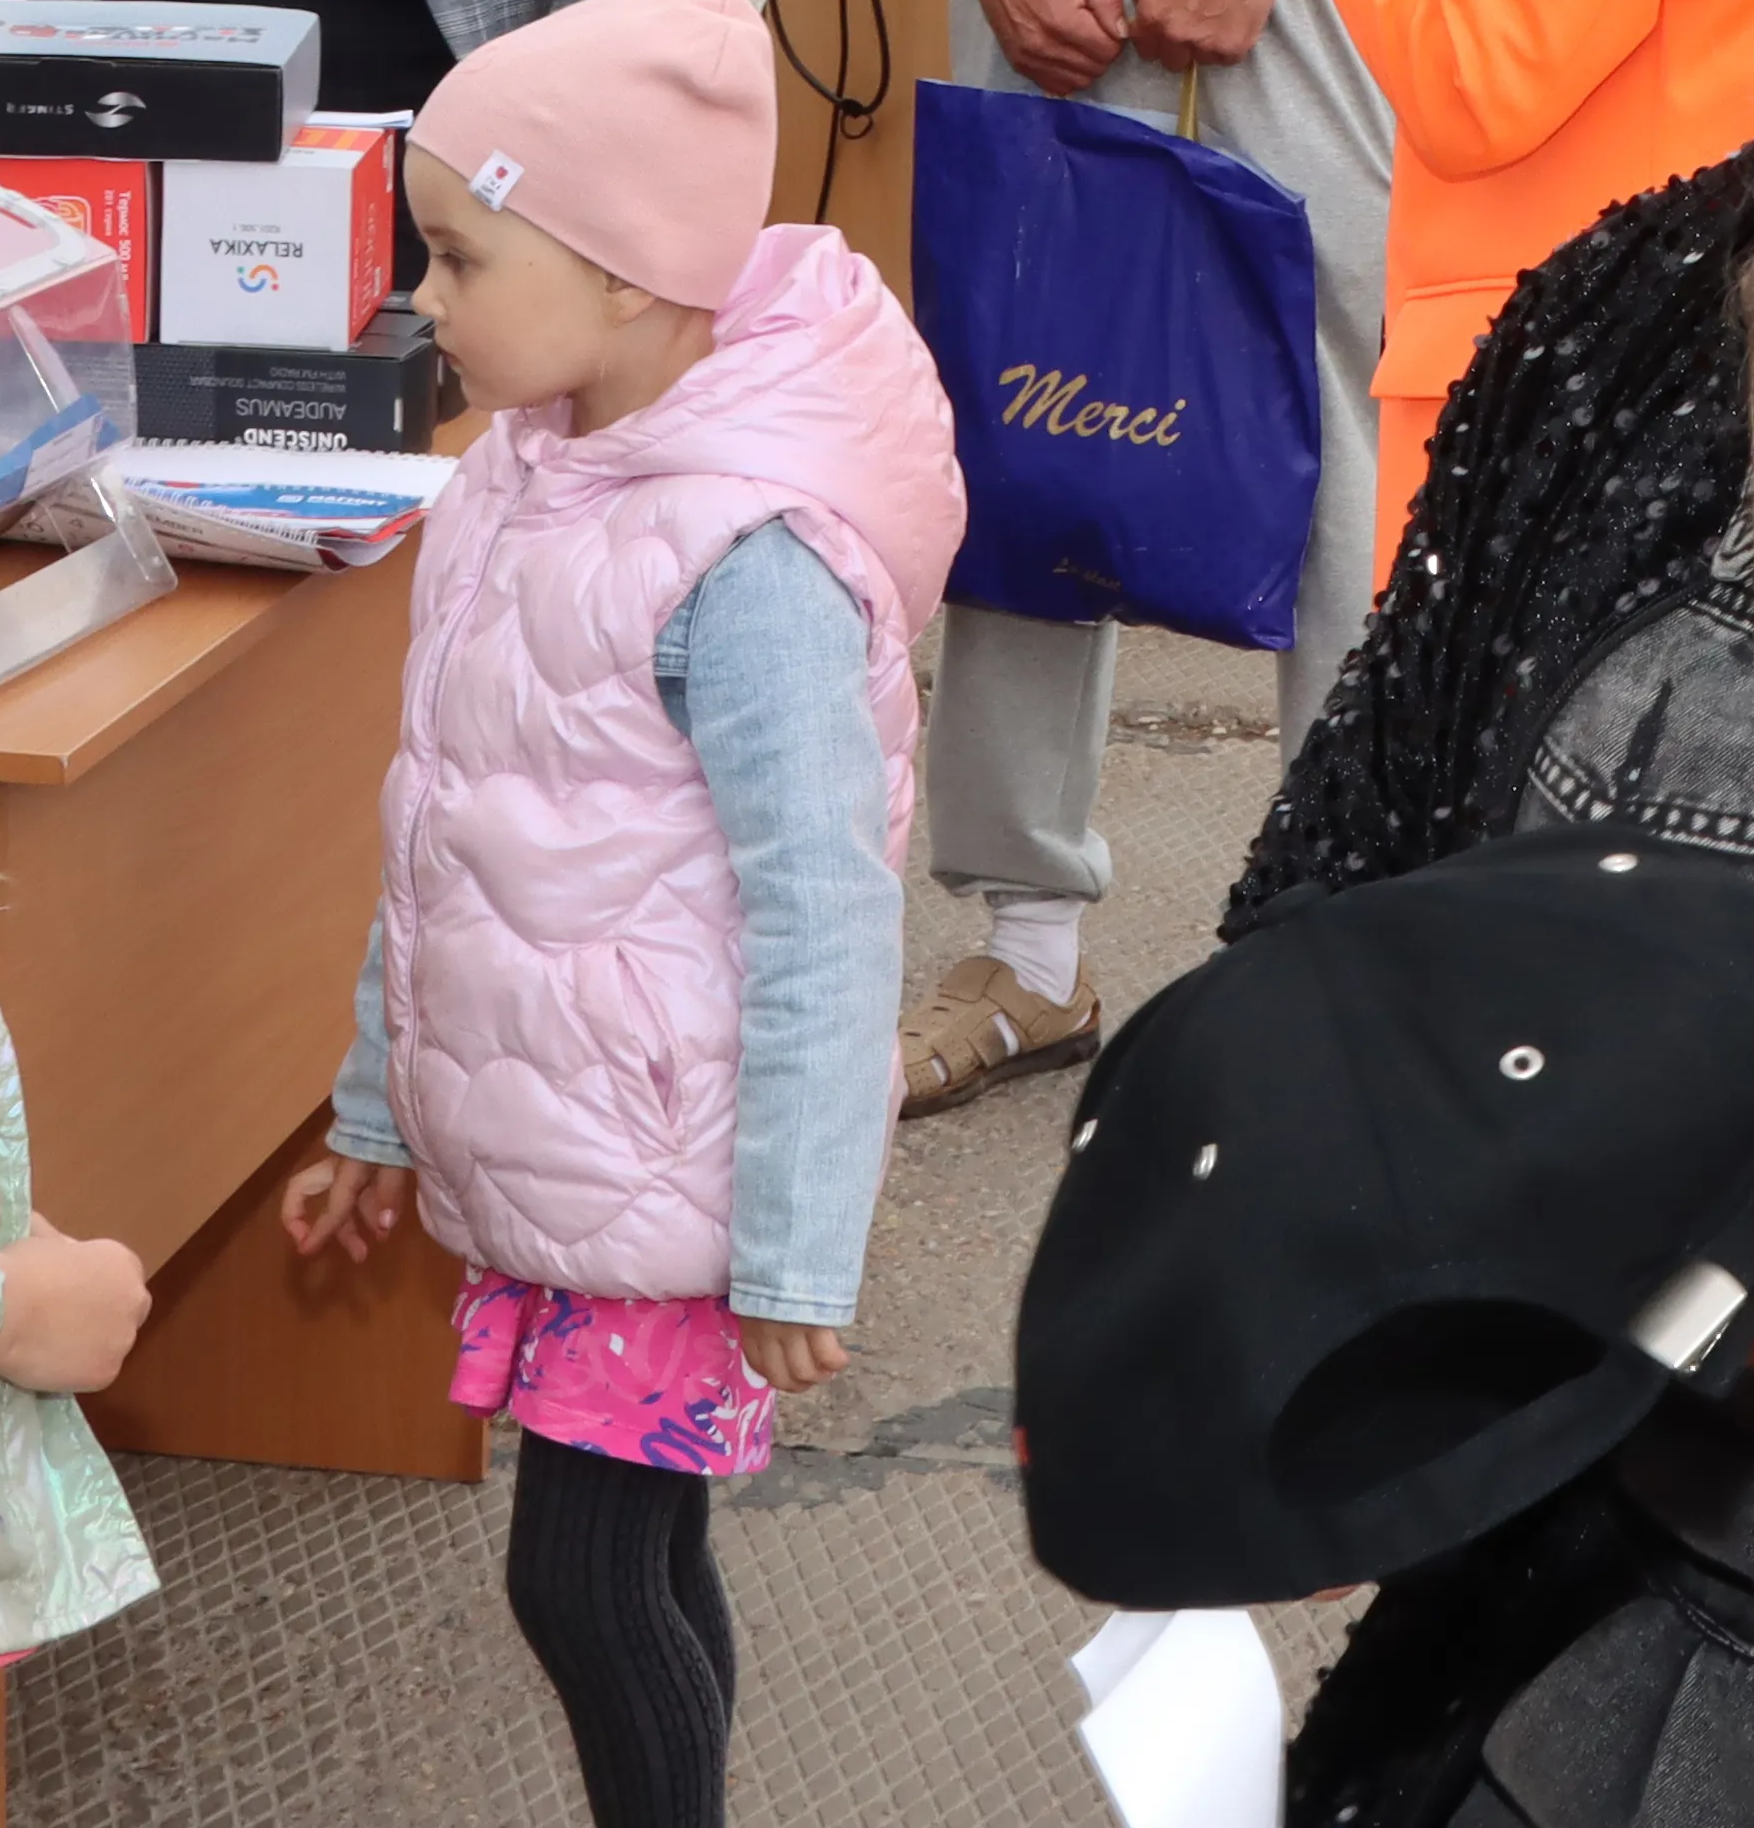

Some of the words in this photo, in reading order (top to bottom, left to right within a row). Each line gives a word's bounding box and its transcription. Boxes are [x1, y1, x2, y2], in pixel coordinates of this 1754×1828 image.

[116, 190, 132, 237] Термос
[118, 239, 132, 261] 500
[208, 238, 304, 259] RELAXIKA
[234, 397, 348, 421] AUDEAMUS
[997, 362, 1188, 447] Merci
[243, 427, 348, 450] UNISCEND
